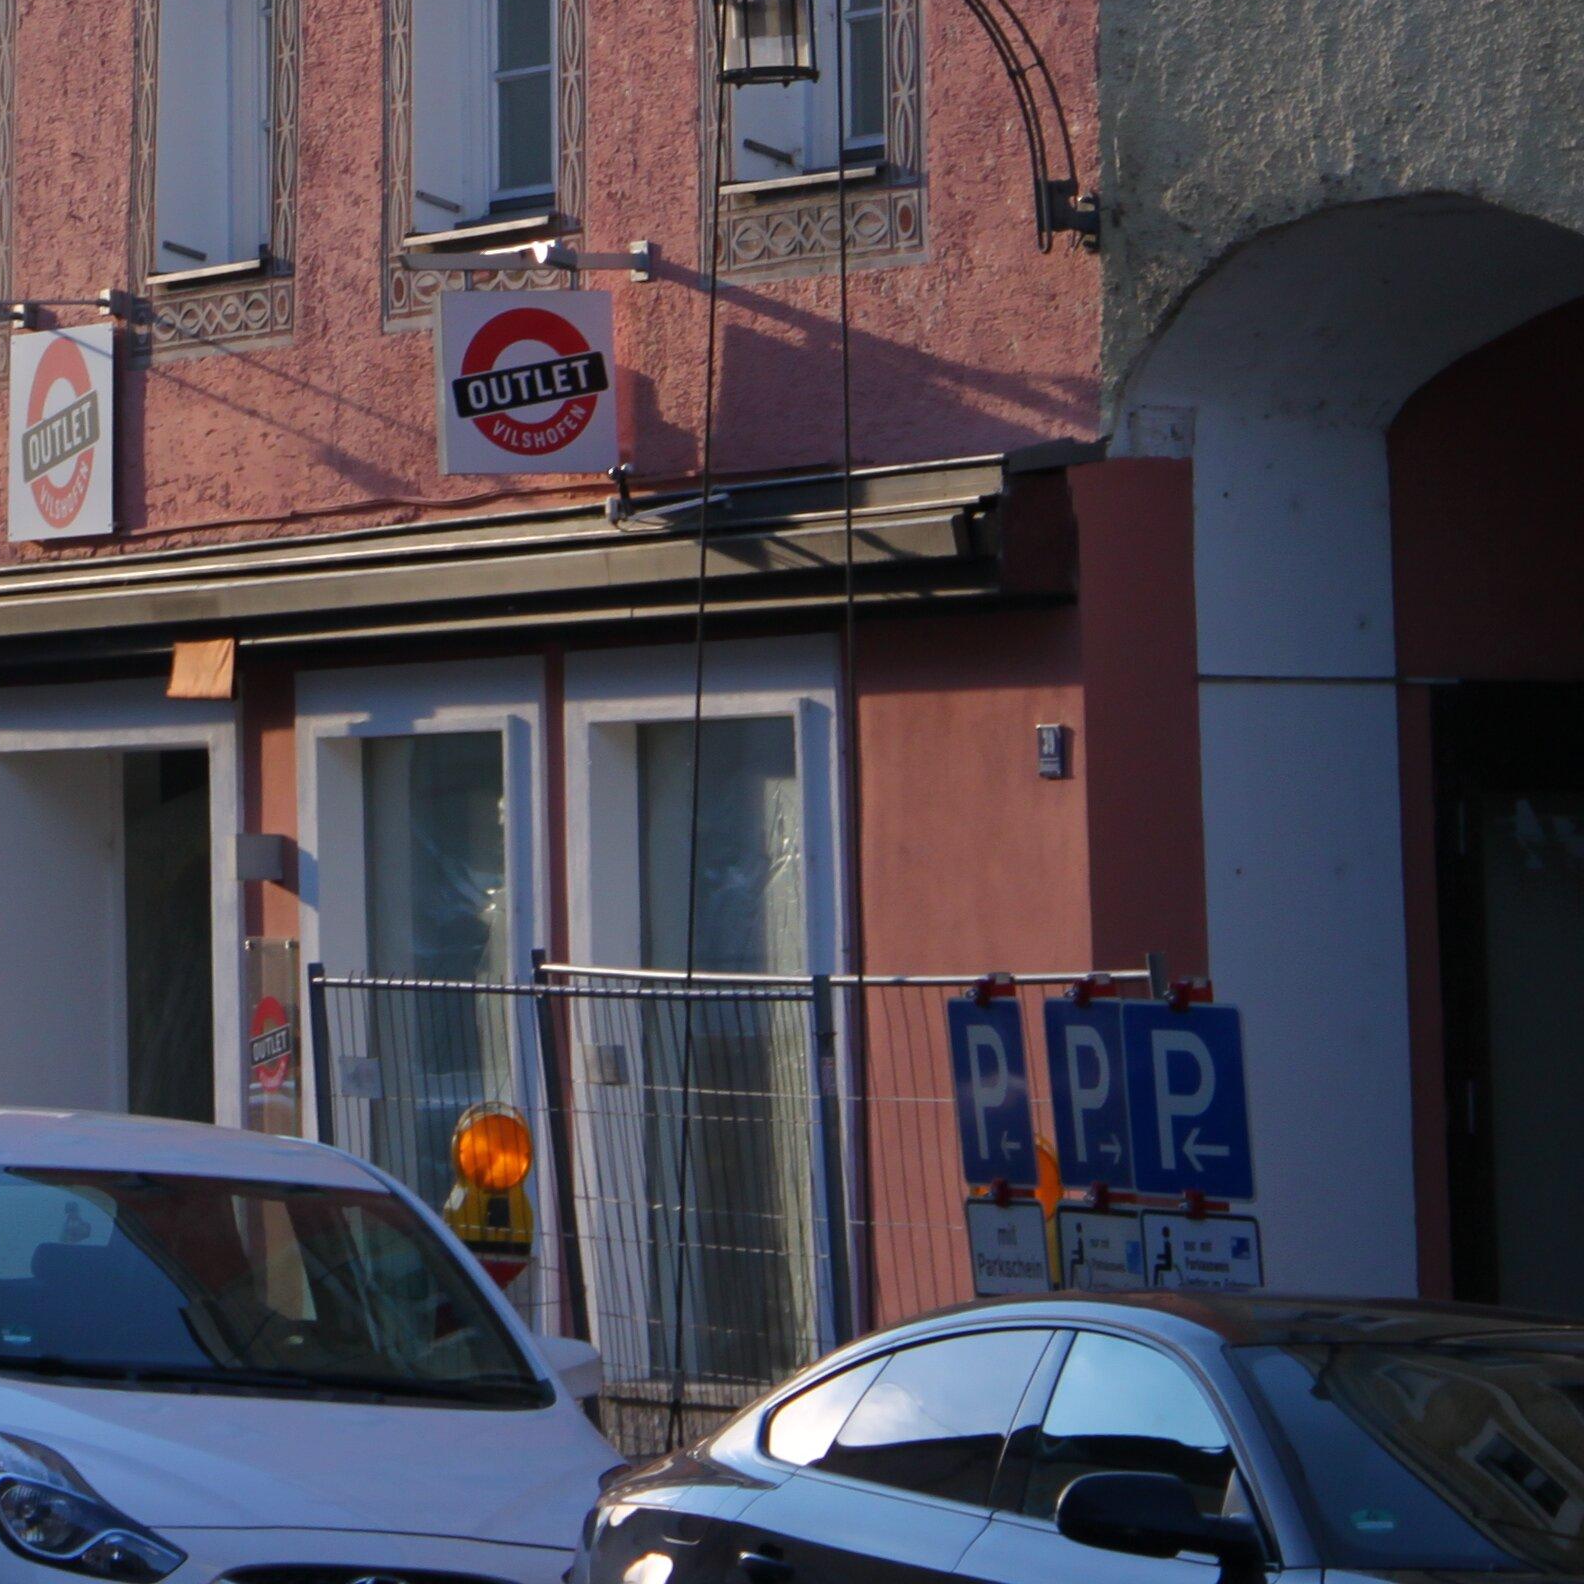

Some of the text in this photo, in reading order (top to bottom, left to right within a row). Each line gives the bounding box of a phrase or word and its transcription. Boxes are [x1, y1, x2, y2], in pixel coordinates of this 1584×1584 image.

[467, 359, 590, 410] OUTLET
[29, 401, 92, 471] OUTLET
[492, 404, 587, 449] VILSHOFEN
[40, 460, 90, 520] VILSHOFEN
[966, 1024, 1009, 1160] P
[1065, 1024, 1110, 1163] P
[1151, 1029, 1216, 1170] P
[976, 1253, 1044, 1280] Parkschein
